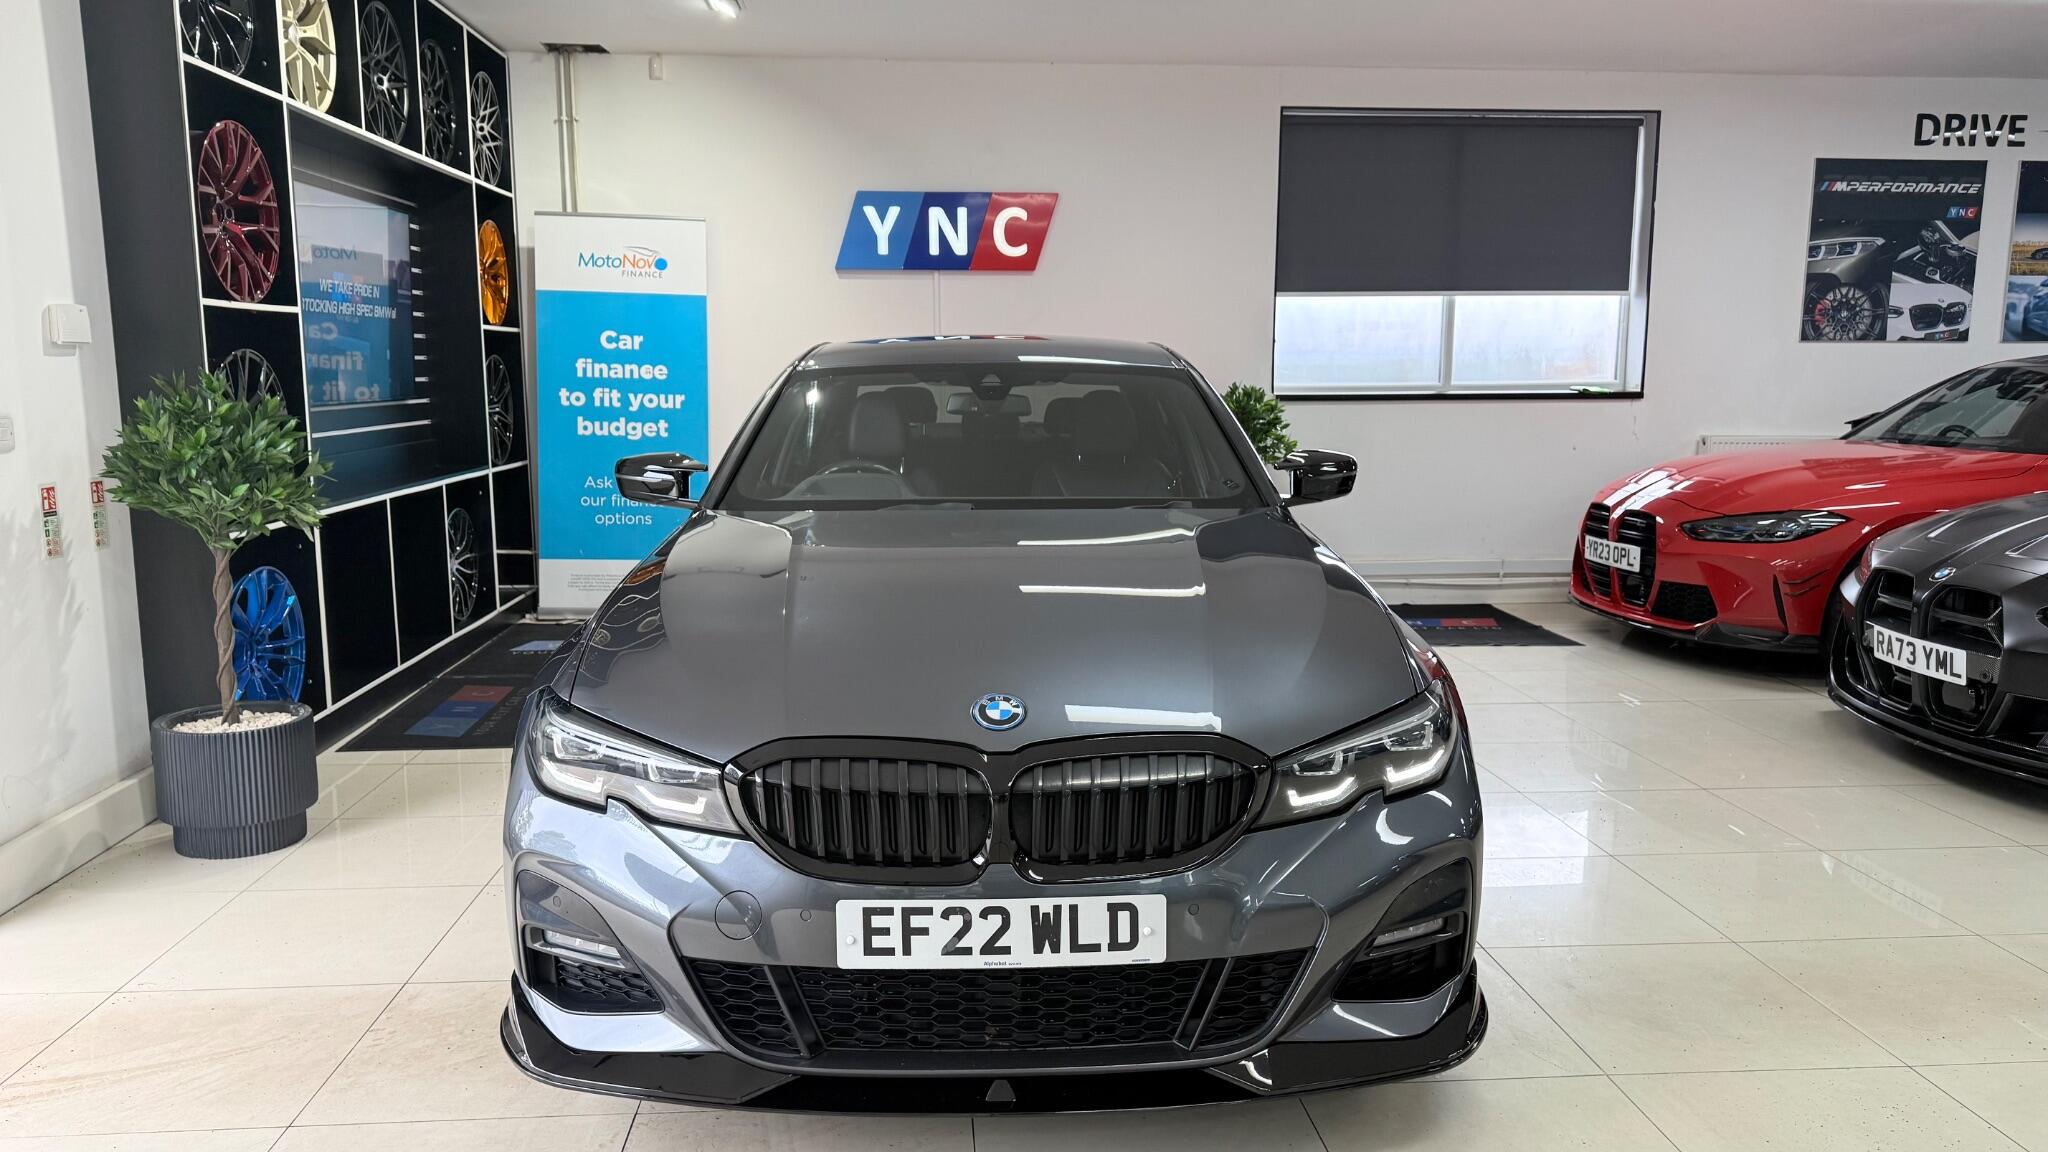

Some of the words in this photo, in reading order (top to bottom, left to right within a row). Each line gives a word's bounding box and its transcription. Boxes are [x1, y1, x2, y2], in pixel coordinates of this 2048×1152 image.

[1914, 113, 2028, 147] DRIVE
[1950, 207, 1976, 217] YNC
[862, 205, 1028, 257] YNC
[621, 270, 664, 279] FINANCE
[319, 278, 333, 292] WE
[334, 280, 353, 295] TAKE
[353, 283, 372, 298] PRIDE
[373, 286, 380, 298] IN
[338, 301, 355, 315] HIGH
[356, 303, 373, 318] SPEC
[600, 330, 643, 351] Car
[575, 358, 669, 380] finance
[559, 388, 586, 406] to
[593, 388, 621, 408] fit
[628, 393, 686, 411] your
[577, 416, 669, 440] budget
[584, 475, 613, 489] Ask
[580, 496, 606, 507] our
[594, 512, 652, 527] options
[1588, 538, 1611, 561] YR23
[1613, 545, 1634, 567] OPL
[1876, 629, 1917, 666] RA73
[1922, 644, 1962, 679] YML
[862, 905, 1012, 957] EF22
[1030, 902, 1139, 955] WLD
